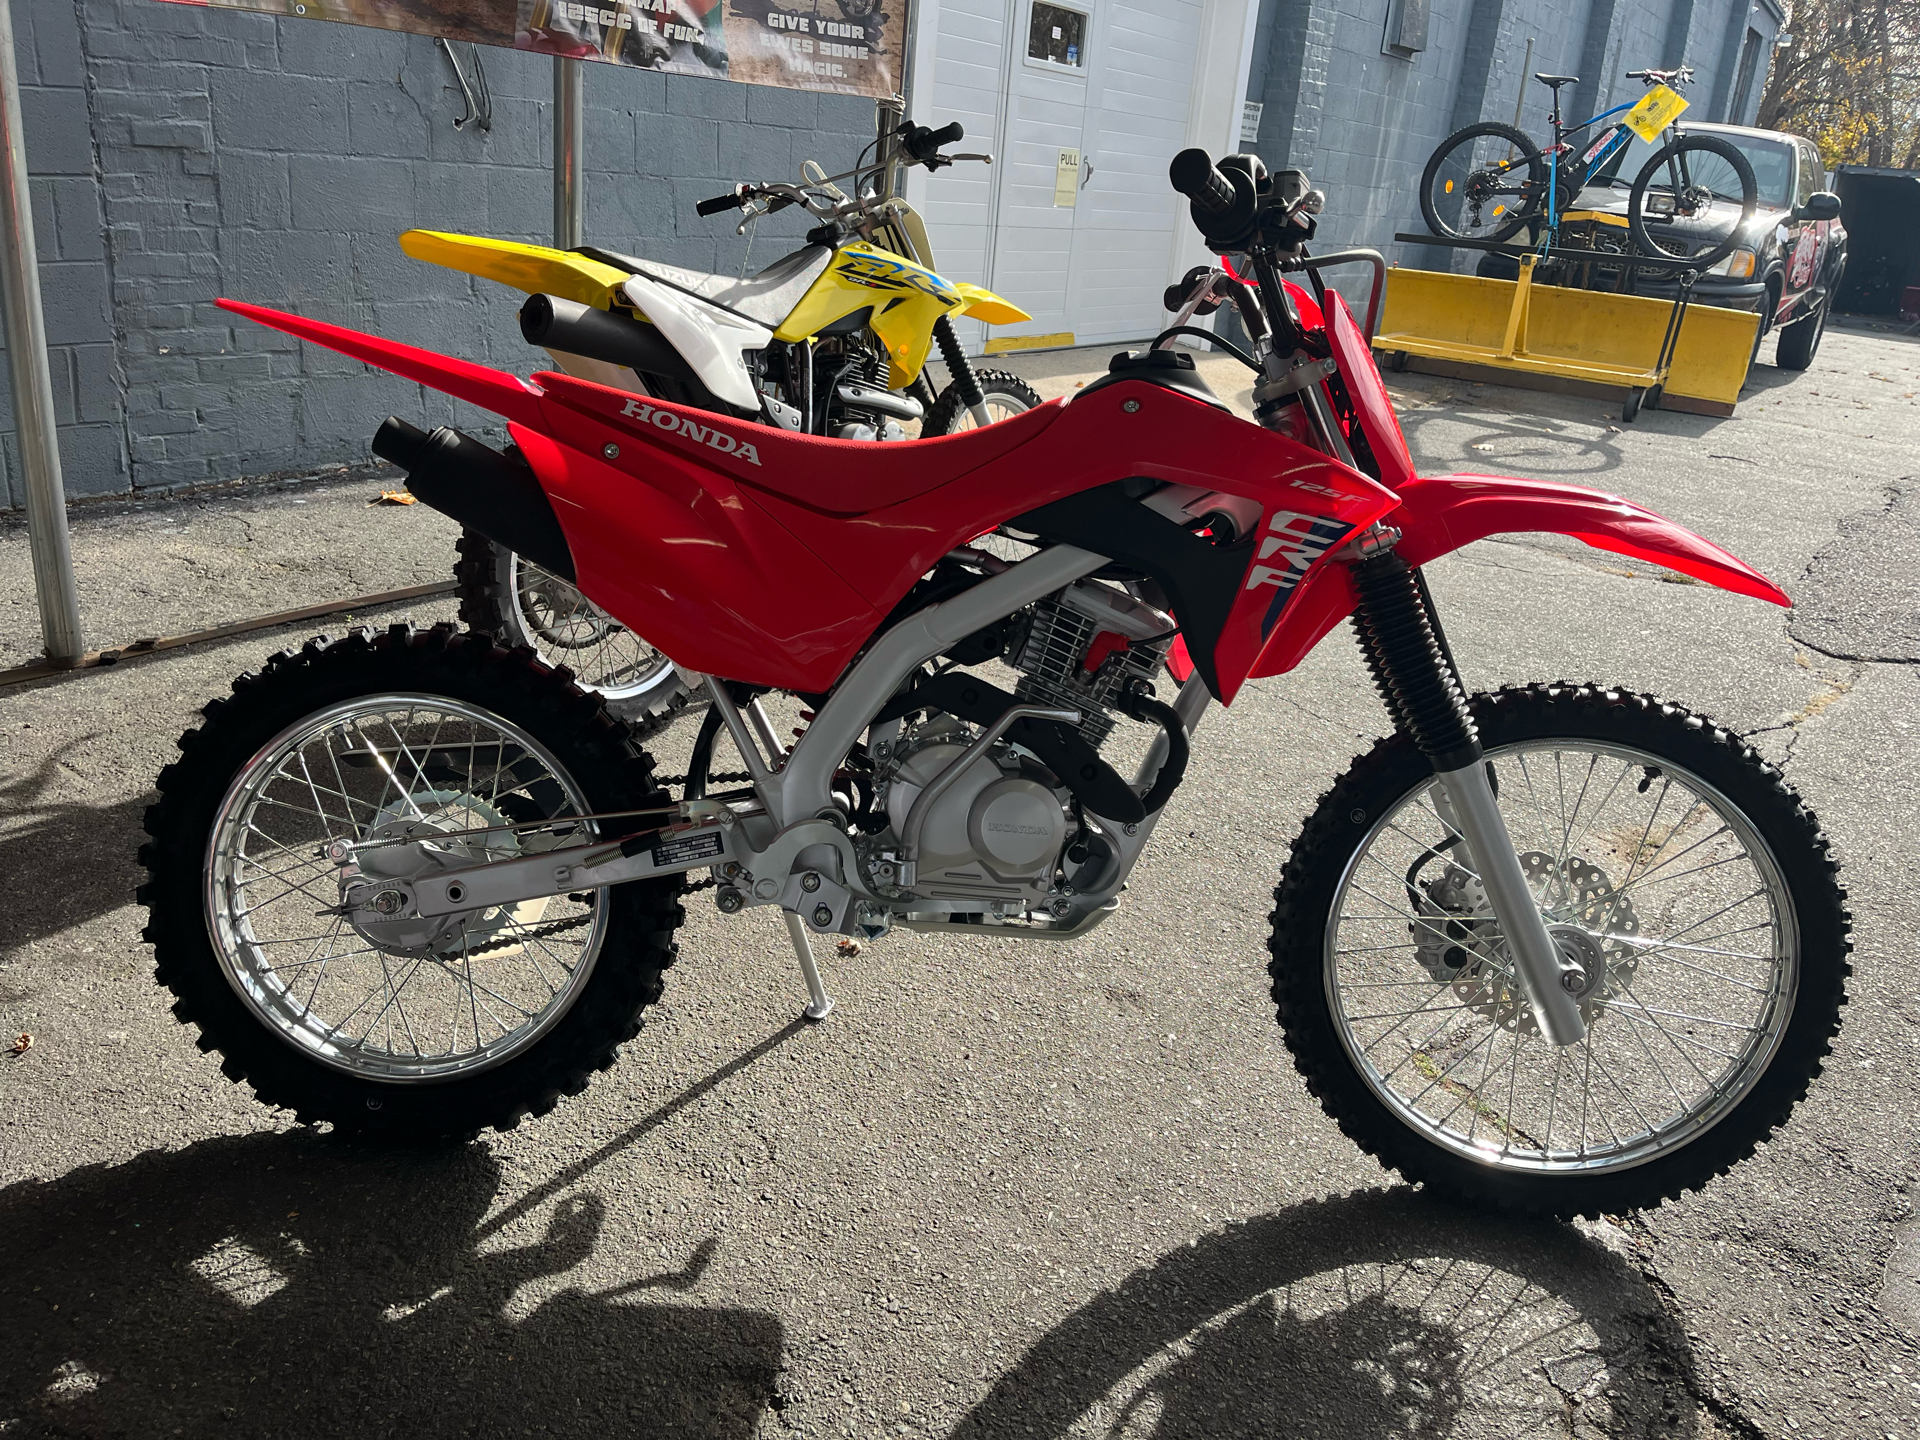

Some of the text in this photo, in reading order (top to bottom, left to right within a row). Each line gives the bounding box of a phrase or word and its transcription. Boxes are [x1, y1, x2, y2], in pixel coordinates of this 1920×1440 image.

[558, 1, 632, 30] 125CC
[637, 16, 659, 34] OF
[767, 12, 865, 39] GIVE YOUR
[820, 41, 869, 60] SOME
[788, 57, 848, 78] MAGIC.
[1060, 153, 1078, 166] PULL
[644, 263, 710, 293] SUZUKI
[619, 398, 762, 467] HONDA
[1289, 479, 1372, 502] 125F
[1245, 510, 1347, 590] CRF
[988, 822, 1048, 836] HONDA
